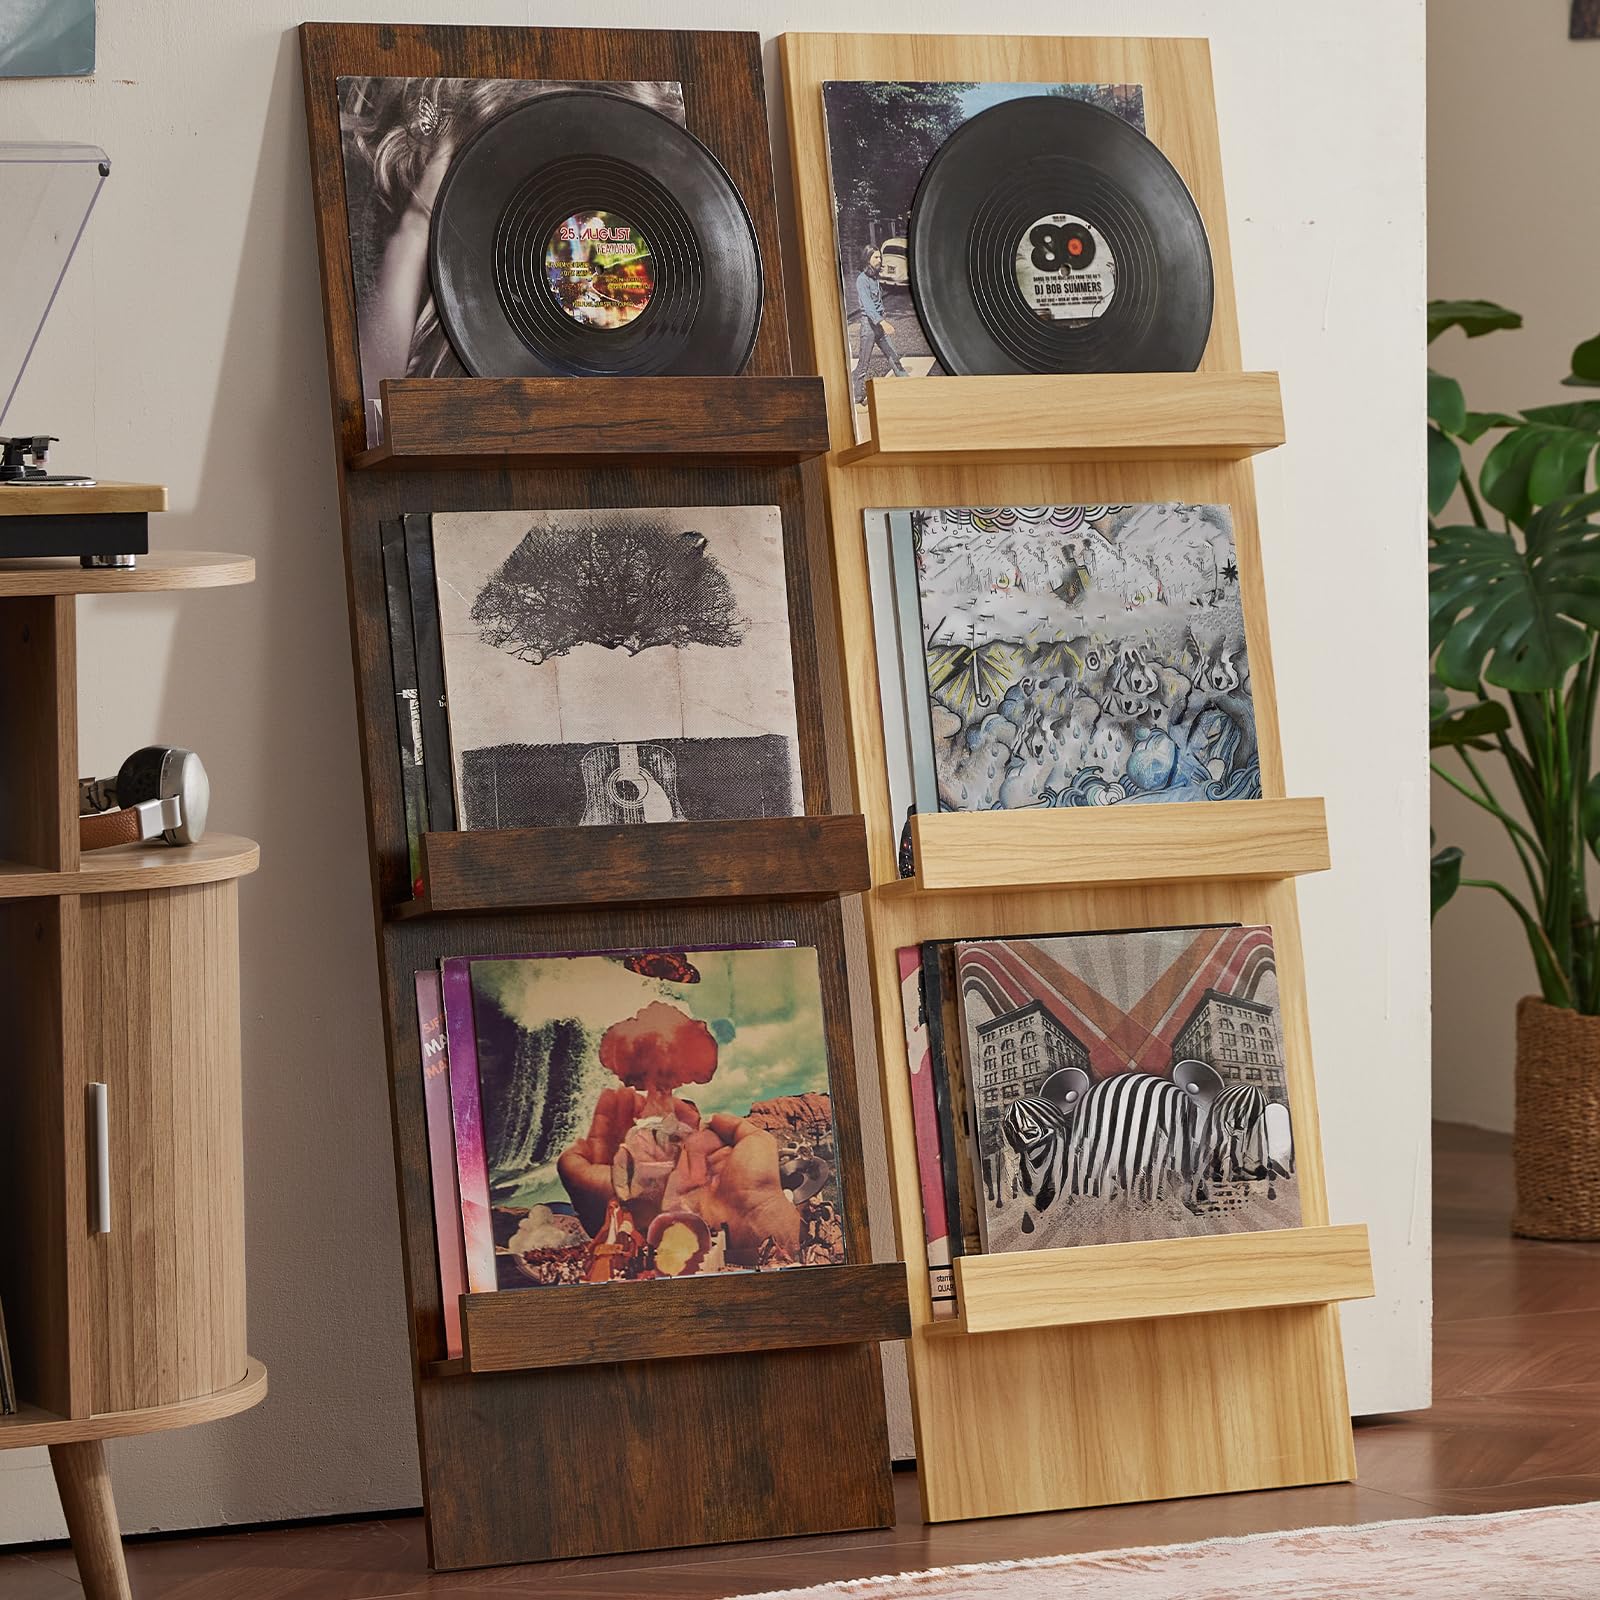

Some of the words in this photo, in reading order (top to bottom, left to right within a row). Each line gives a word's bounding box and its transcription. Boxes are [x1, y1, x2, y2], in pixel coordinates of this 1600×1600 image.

[560, 227, 579, 241] 25.
[581, 227, 630, 241] AUGUST
[596, 242, 637, 254] FEATURING
[1029, 223, 1096, 272] 80
[1035, 284, 1044, 295] DJ
[1046, 283, 1062, 294] BOB
[1064, 281, 1102, 293] SUMMERS
